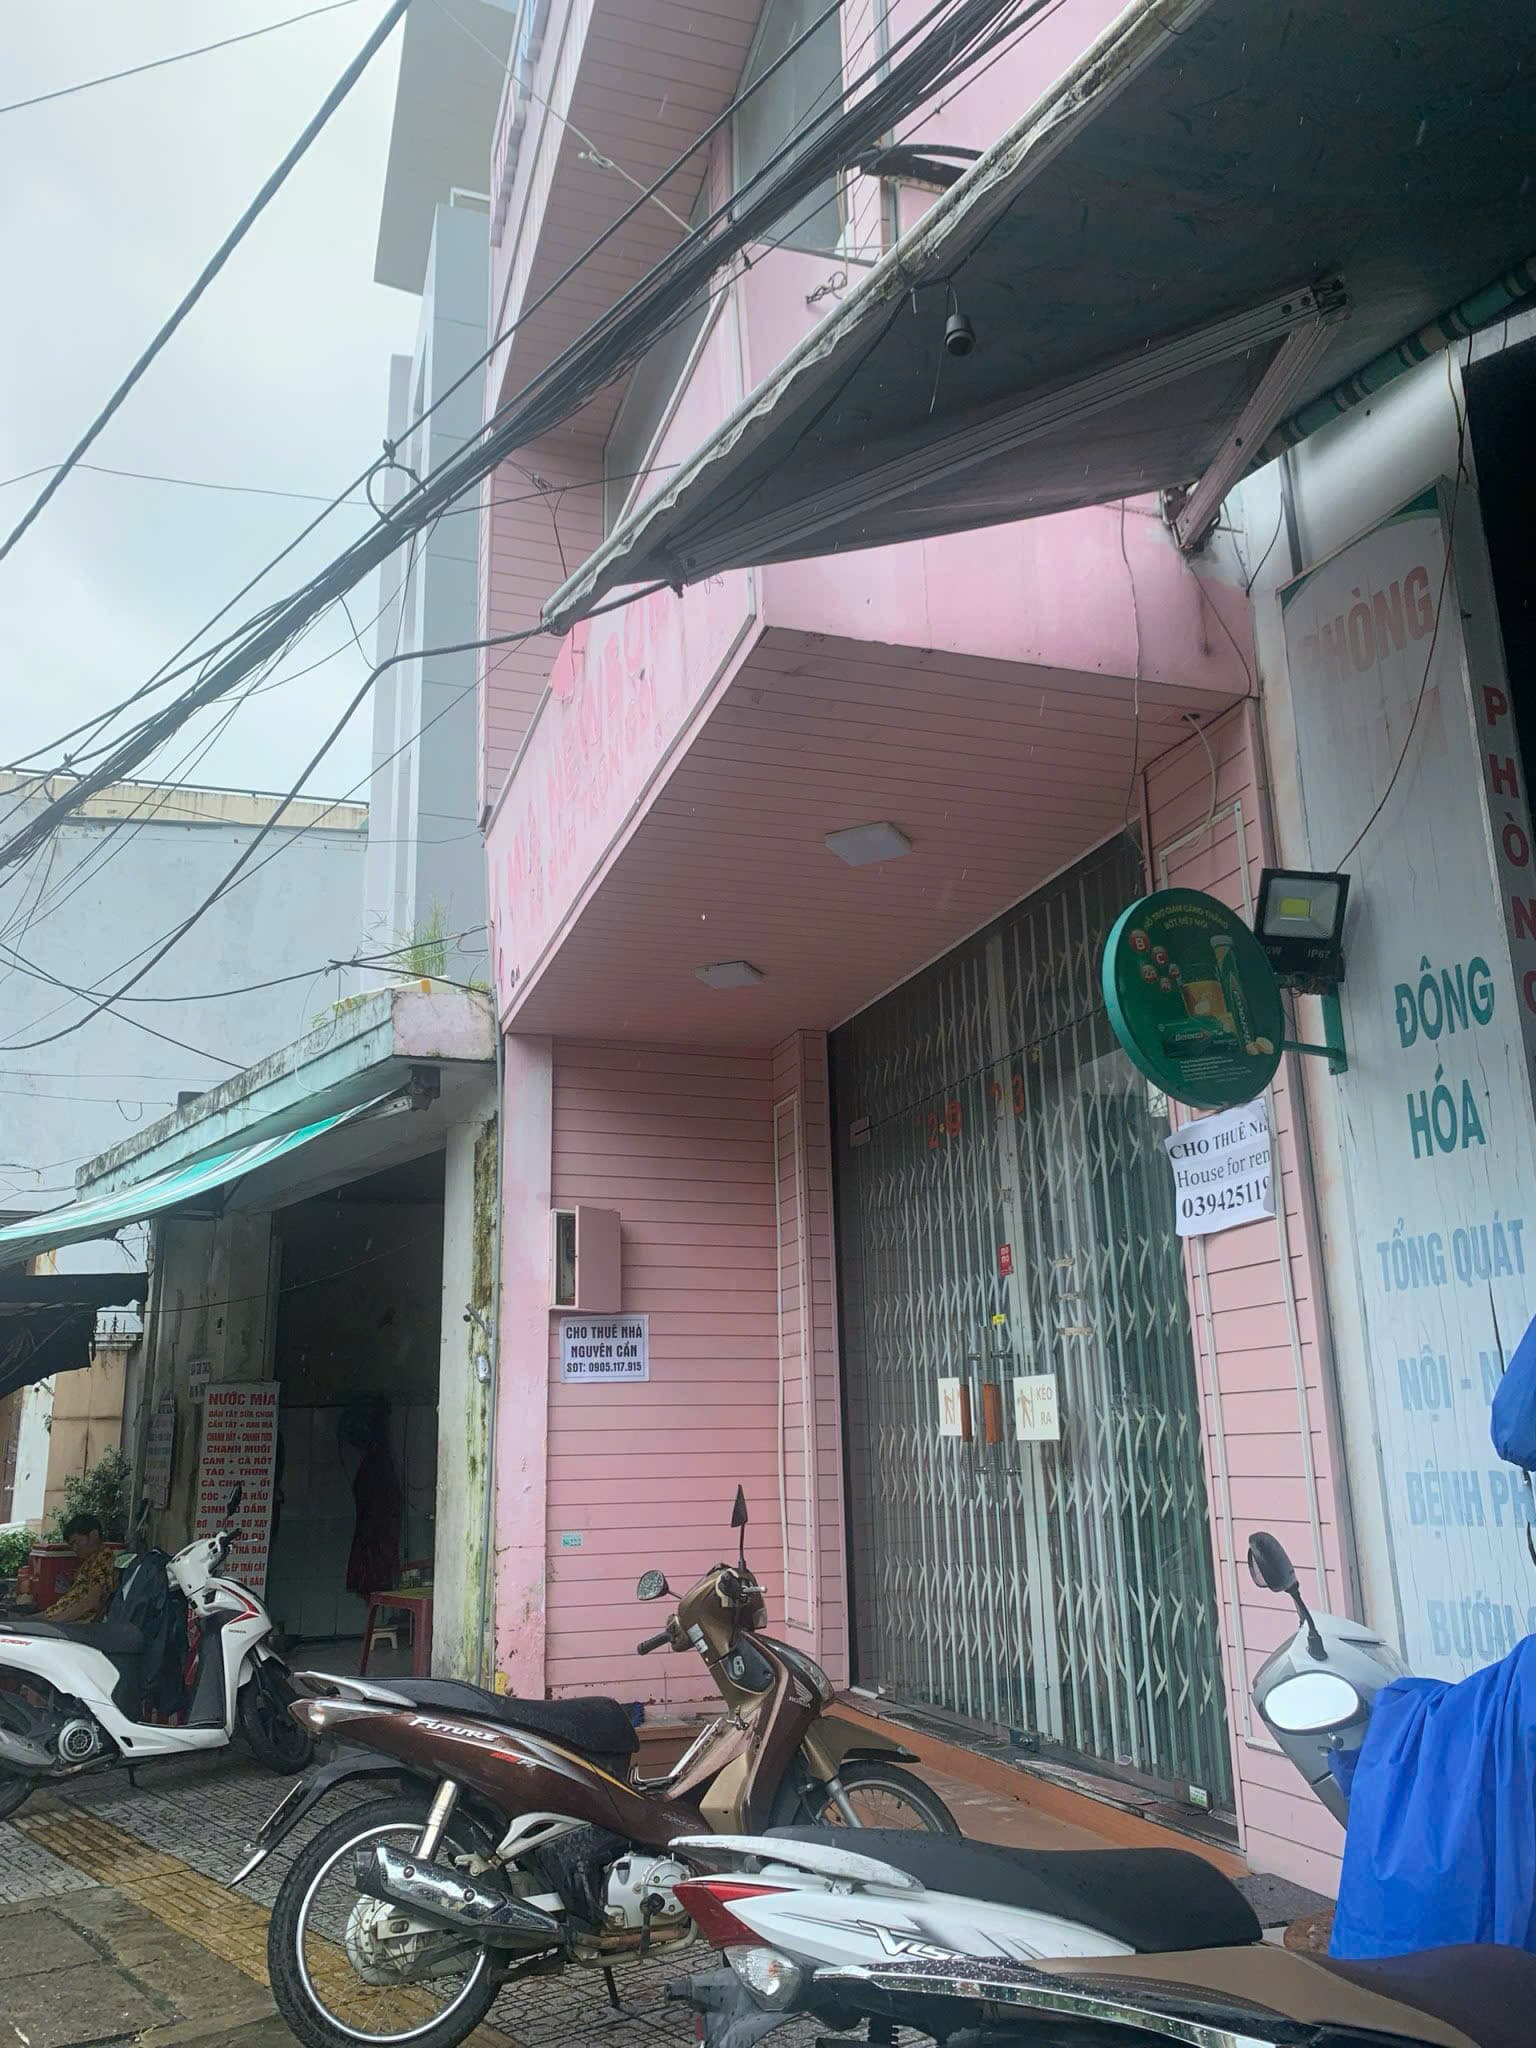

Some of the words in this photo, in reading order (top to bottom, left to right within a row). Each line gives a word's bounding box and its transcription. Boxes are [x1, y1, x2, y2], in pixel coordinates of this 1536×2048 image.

[1394, 955, 1495, 1048] ĐÔNG
[1406, 1063, 1486, 1159] HÓA
[1169, 1139, 1209, 1160] CHO
[1212, 1121, 1247, 1150] THUÊ
[1176, 1165, 1224, 1188] House
[1227, 1157, 1247, 1176] for
[1376, 1216, 1448, 1292] TỔNG
[1452, 1210, 1526, 1288] QUÁT
[566, 1326, 588, 1339] CHO
[591, 1324, 618, 1339] THUÊ
[621, 1323, 643, 1339] NHÀ
[571, 1342, 613, 1358] NGUYÊN
[588, 1361, 642, 1373] 0905.117.915
[1398, 1344, 1452, 1421] NỘI
[209, 1391, 246, 1405] NƯỚC
[202, 1457, 225, 1465] CAM
[207, 1444, 241, 1453] CHANH
[201, 1505, 226, 1513] SINH
[1406, 1459, 1486, 1539] BỆNH
[408, 1715, 500, 1742] FUTURE
[856, 1919, 967, 1961] VIS
